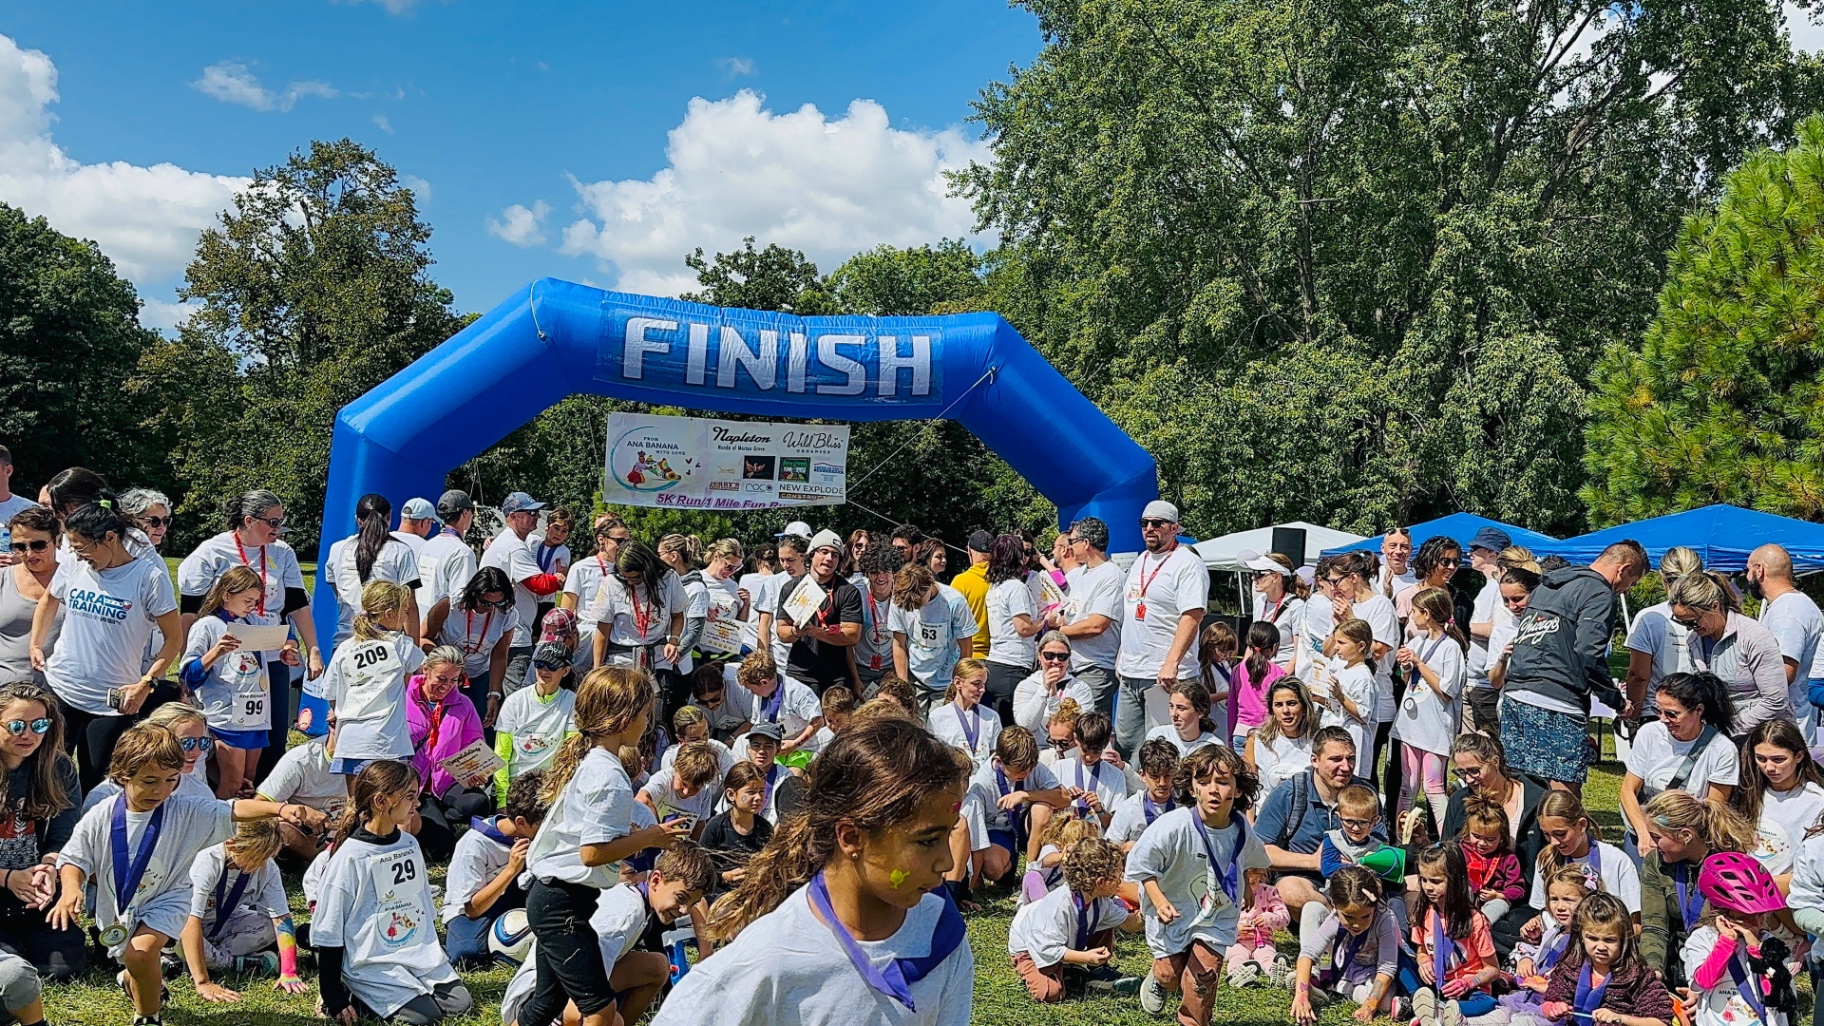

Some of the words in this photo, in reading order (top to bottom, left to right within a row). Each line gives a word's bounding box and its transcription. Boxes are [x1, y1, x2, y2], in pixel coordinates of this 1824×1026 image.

[622, 316, 931, 397] FINISH
[712, 426, 771, 444] Napleton
[783, 431, 813, 448] Wild
[813, 432, 843, 449] Bliss
[627, 440, 644, 448] ANA
[645, 442, 679, 450] BANANA
[780, 484, 801, 492] NEW
[803, 485, 844, 495] EXPLODE
[657, 493, 676, 504] 5K
[677, 494, 712, 506] Run/1
[715, 498, 740, 508] Mile
[743, 500, 766, 508] Fun
[70, 588, 105, 605] CARA
[69, 599, 127, 620] TRAINING
[921, 628, 937, 640] 63
[1514, 611, 1560, 645] Chicago
[354, 645, 388, 669] 209
[245, 700, 263, 715] 99
[379, 856, 392, 864] Ana
[391, 859, 416, 885] 29
